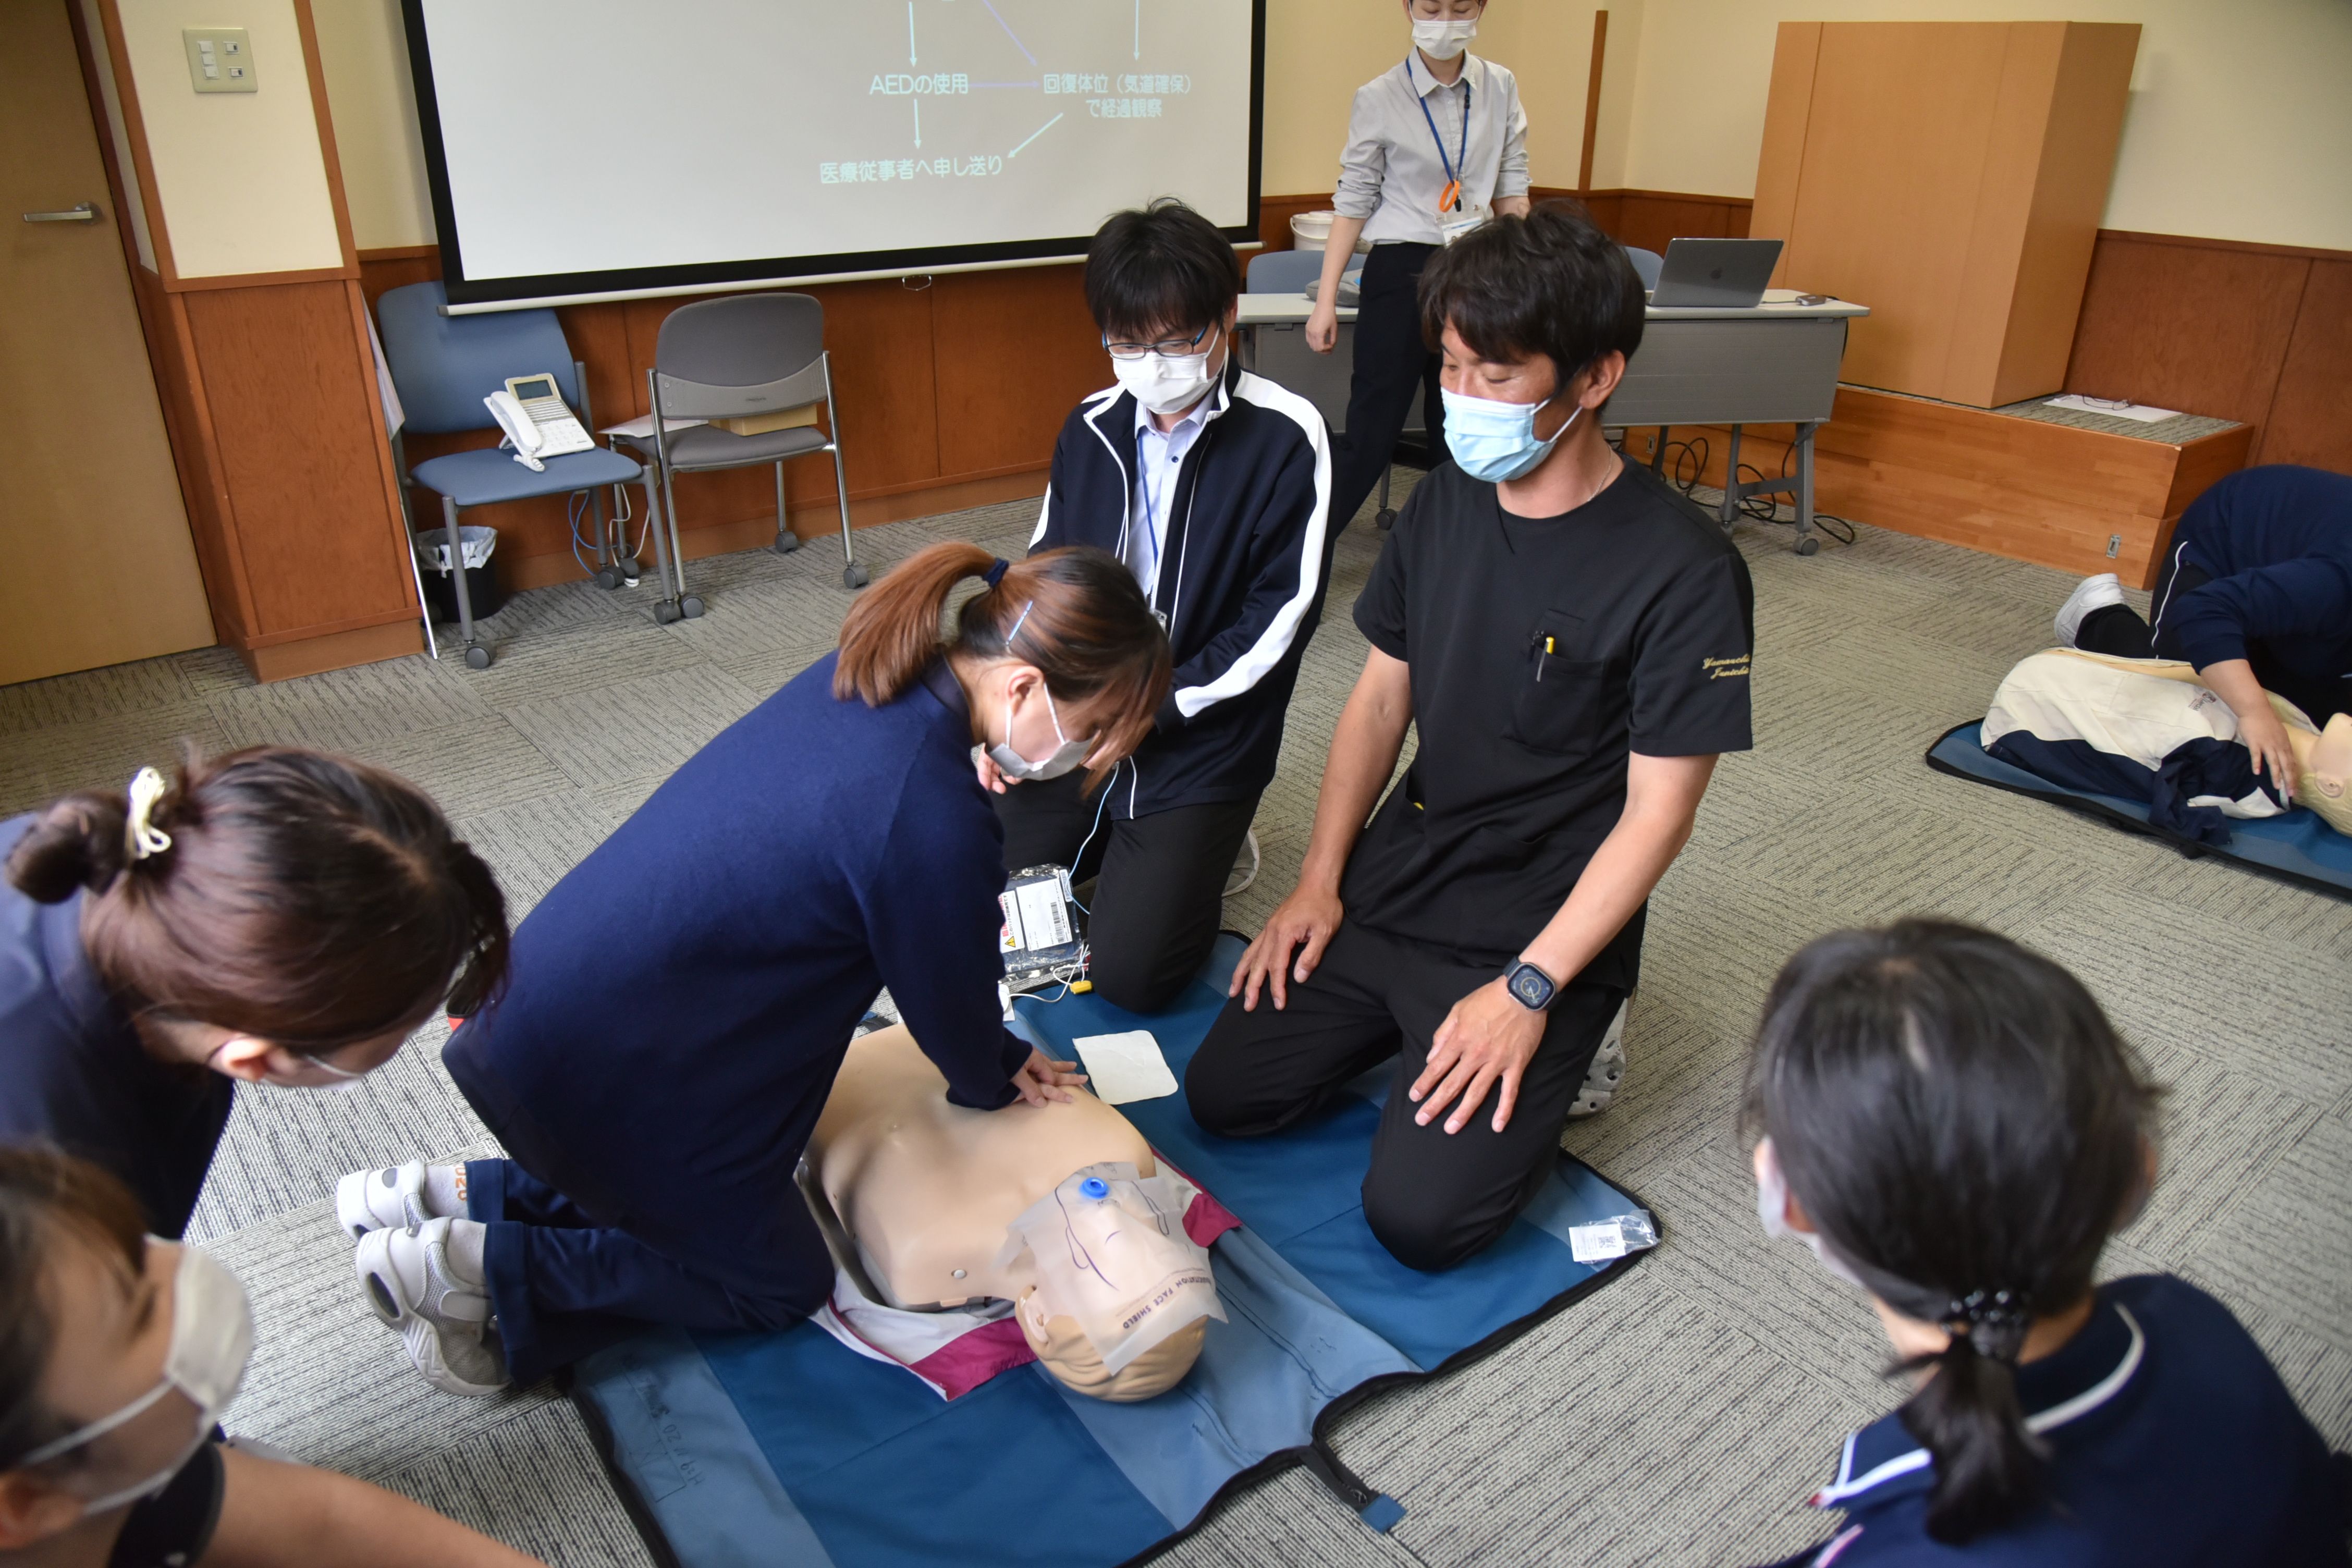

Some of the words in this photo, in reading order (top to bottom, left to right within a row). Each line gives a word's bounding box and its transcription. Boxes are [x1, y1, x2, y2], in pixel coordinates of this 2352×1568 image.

[869, 74, 969, 94] AEDの使用
[1085, 98, 1162, 118] で経過観察
[820, 155, 1002, 184] 医療従事者へ申し送り
[1153, 1287, 1173, 1306] FACE
[1122, 1305, 1152, 1329] SHIELD
